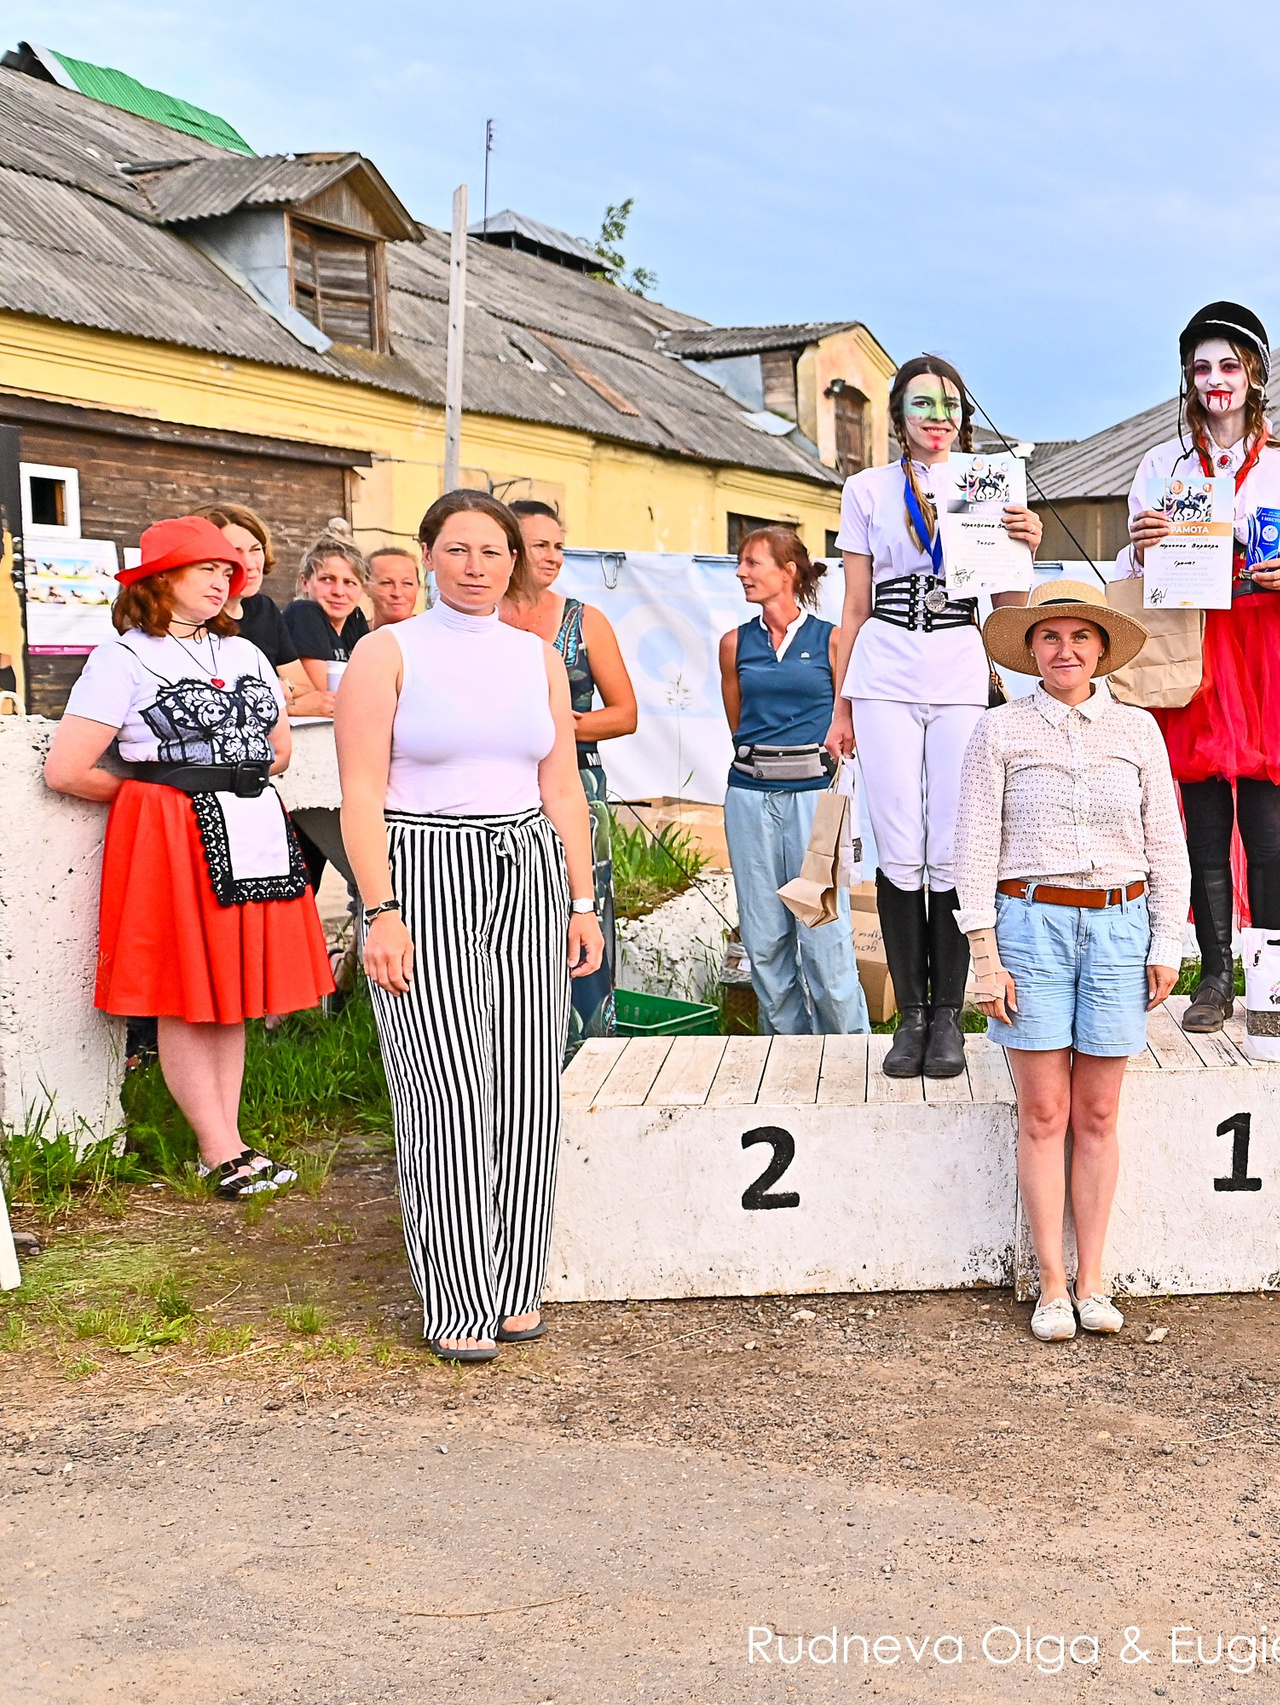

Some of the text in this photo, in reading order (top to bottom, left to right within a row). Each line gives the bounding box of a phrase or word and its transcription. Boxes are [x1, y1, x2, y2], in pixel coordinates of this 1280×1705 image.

[1170, 526, 1210, 534] РАМОТА
[741, 1125, 801, 1211] 2
[1213, 1112, 1263, 1192] 1
